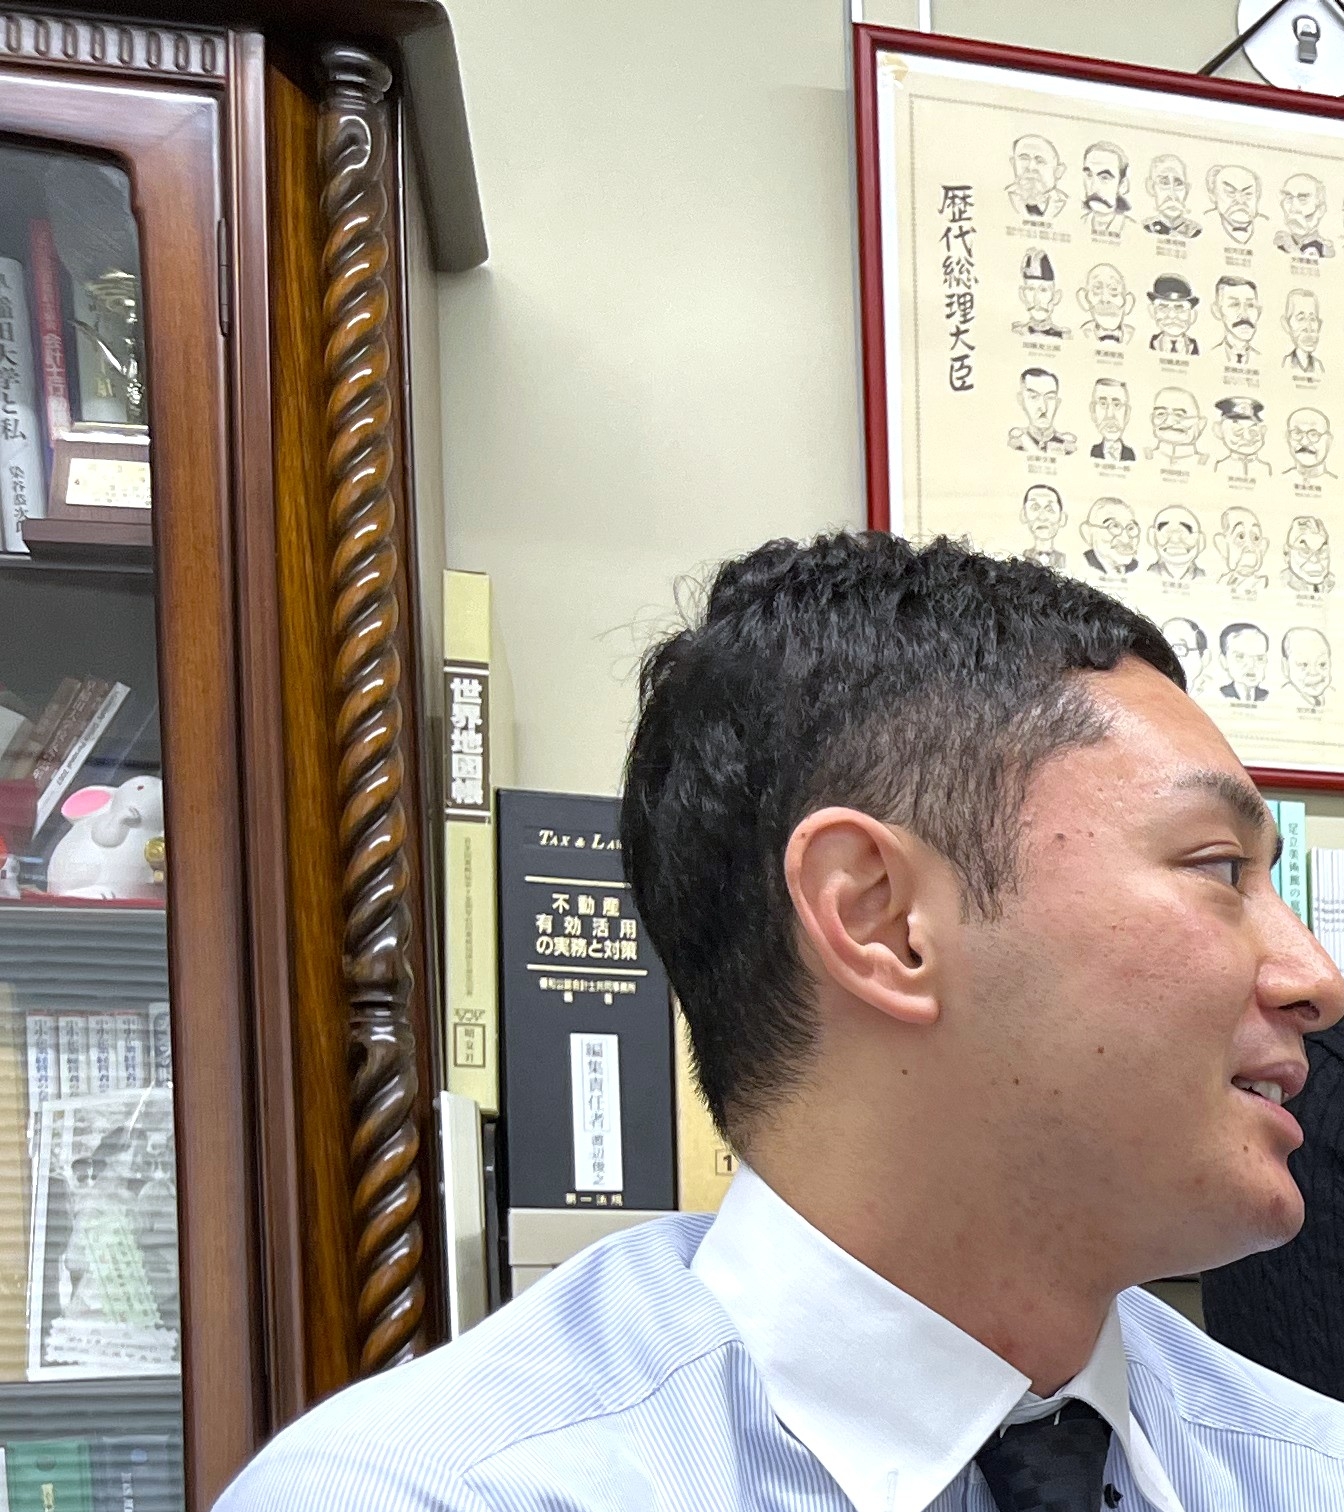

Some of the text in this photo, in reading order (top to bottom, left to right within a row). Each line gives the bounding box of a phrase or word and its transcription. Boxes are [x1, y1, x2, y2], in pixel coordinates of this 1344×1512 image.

[938, 184, 980, 392] 歴代総理大臣
[450, 677, 483, 805] 世界地図帳
[574, 836, 586, 849] &
[552, 892, 620, 917] 不動産
[535, 914, 637, 939] 有効活用
[536, 936, 637, 961] の実務と対策
[586, 1042, 604, 1130] 編集責任者
